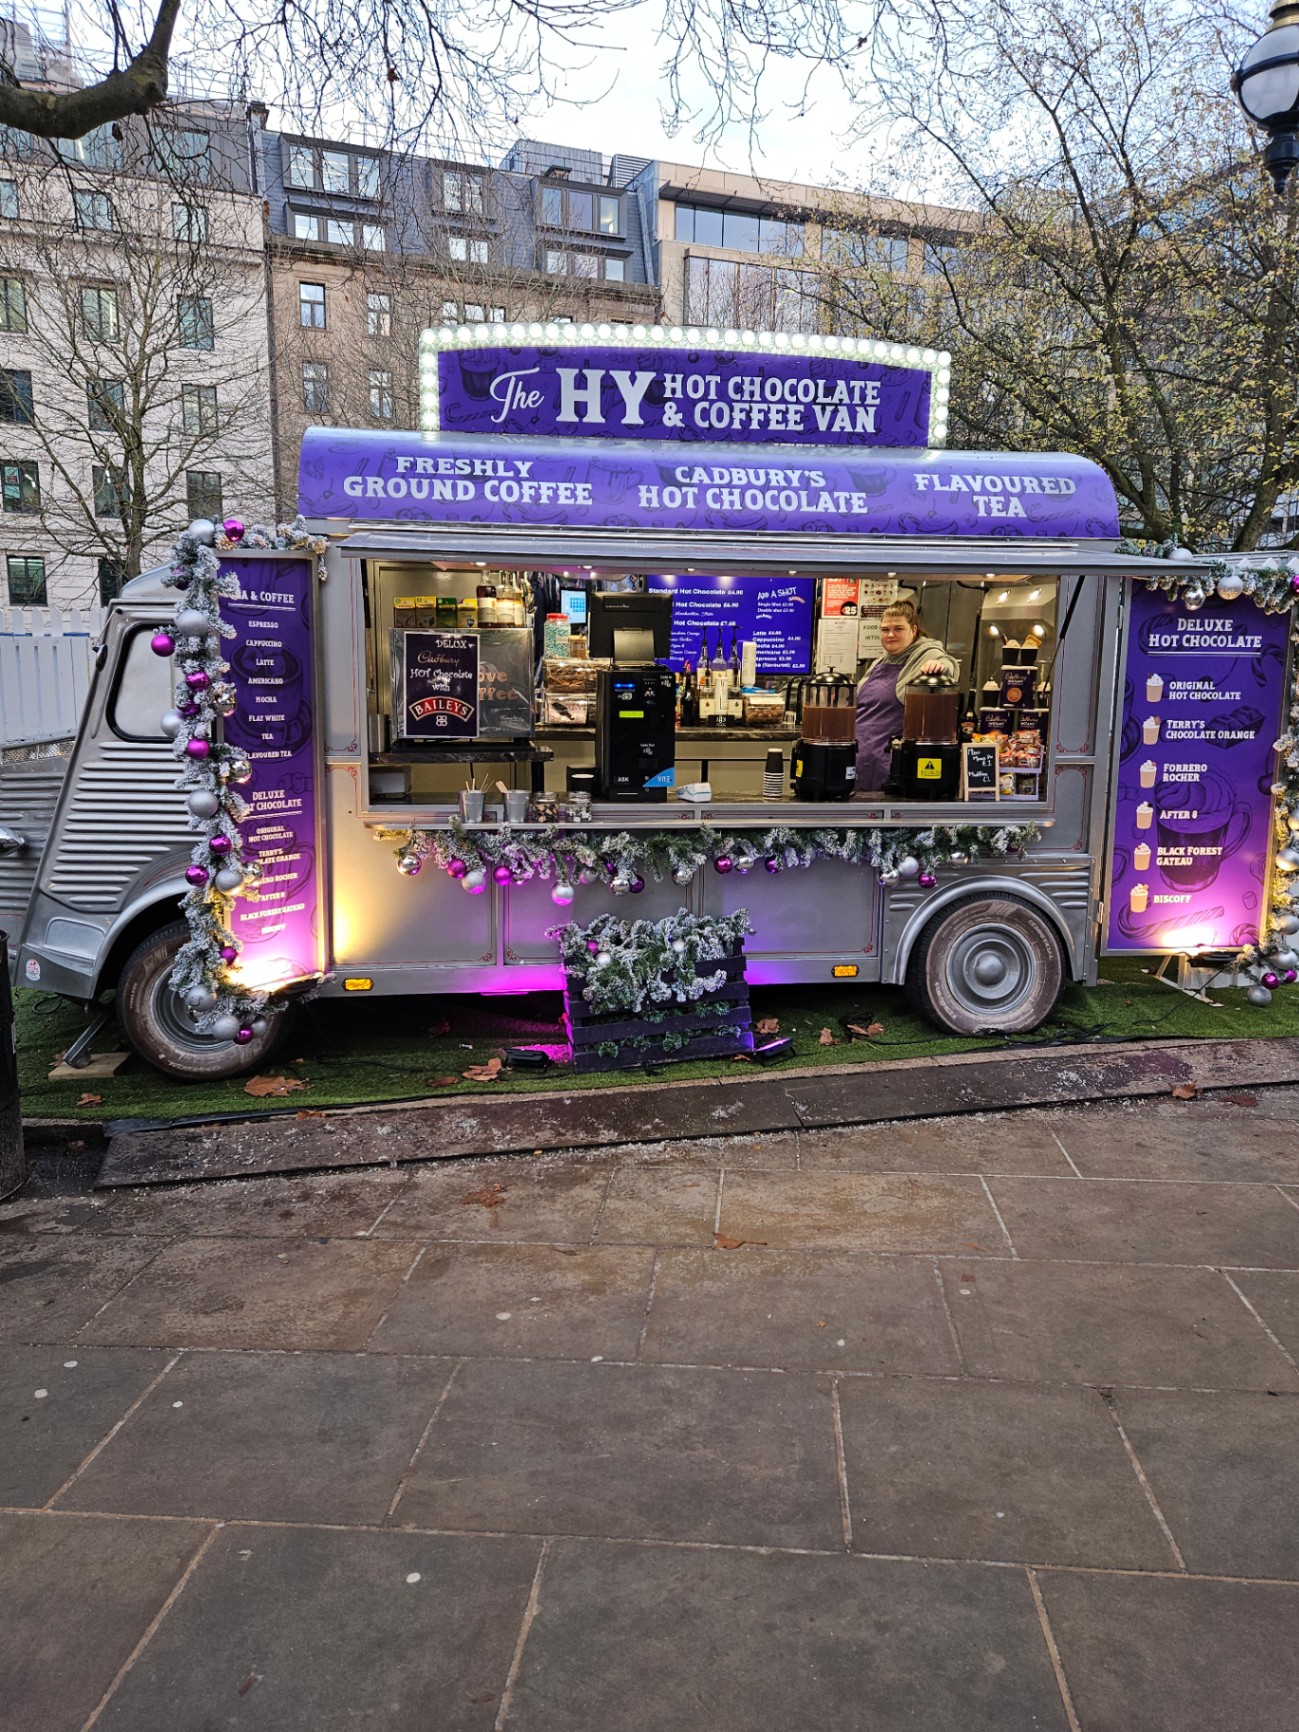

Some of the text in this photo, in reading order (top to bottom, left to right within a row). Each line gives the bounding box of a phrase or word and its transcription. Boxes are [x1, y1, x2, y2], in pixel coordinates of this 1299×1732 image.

[663, 374, 881, 405] HOT CHOCOLATE
[490, 367, 657, 425] The HY
[662, 401, 876, 433] & COFFEE VAN
[396, 456, 534, 478] FRESHLY
[675, 466, 826, 487] CADBURY'S
[915, 473, 1076, 495] FLAVOURED
[343, 475, 592, 506] GROUND COFFEE
[639, 485, 868, 514] HOT CHOCOLATE
[972, 496, 1027, 518] TEA
[250, 590, 258, 601] &
[260, 591, 295, 603] COFFEE
[777, 586, 797, 597] SHOT
[248, 620, 279, 629] ESPRESSO
[1177, 618, 1233, 631] DELUXE
[245, 639, 282, 648] CAPPUCCINO
[1148, 634, 1262, 648] HOT CHOCOLATE
[417, 650, 460, 667] Cadbury
[248, 677, 283, 685] AMERICANO
[478, 671, 508, 683] ove
[1169, 681, 1215, 690] ORIGINAL
[478, 687, 518, 701] ffee
[1169, 691, 1241, 700] HOT CHOCOLATE
[414, 699, 469, 716] BAILEYS
[1166, 719, 1205, 729] TERRY'S
[1166, 730, 1255, 739] CHOCOLATE ORANGE
[245, 751, 279, 759] LAVOURED
[1163, 763, 1208, 772] FORRERO
[1163, 773, 1200, 782] ROCHER
[252, 790, 285, 801] DELUXE
[256, 798, 302, 811] CHOCOLATE
[1160, 810, 1198, 819] AFTER 8
[256, 825, 285, 835] ORIGINAL
[261, 831, 294, 841] CHOCOLATE
[1157, 847, 1223, 856] BLACK FOREST
[1156, 857, 1193, 866] GATEAU
[1153, 895, 1192, 903] BISCOFF
